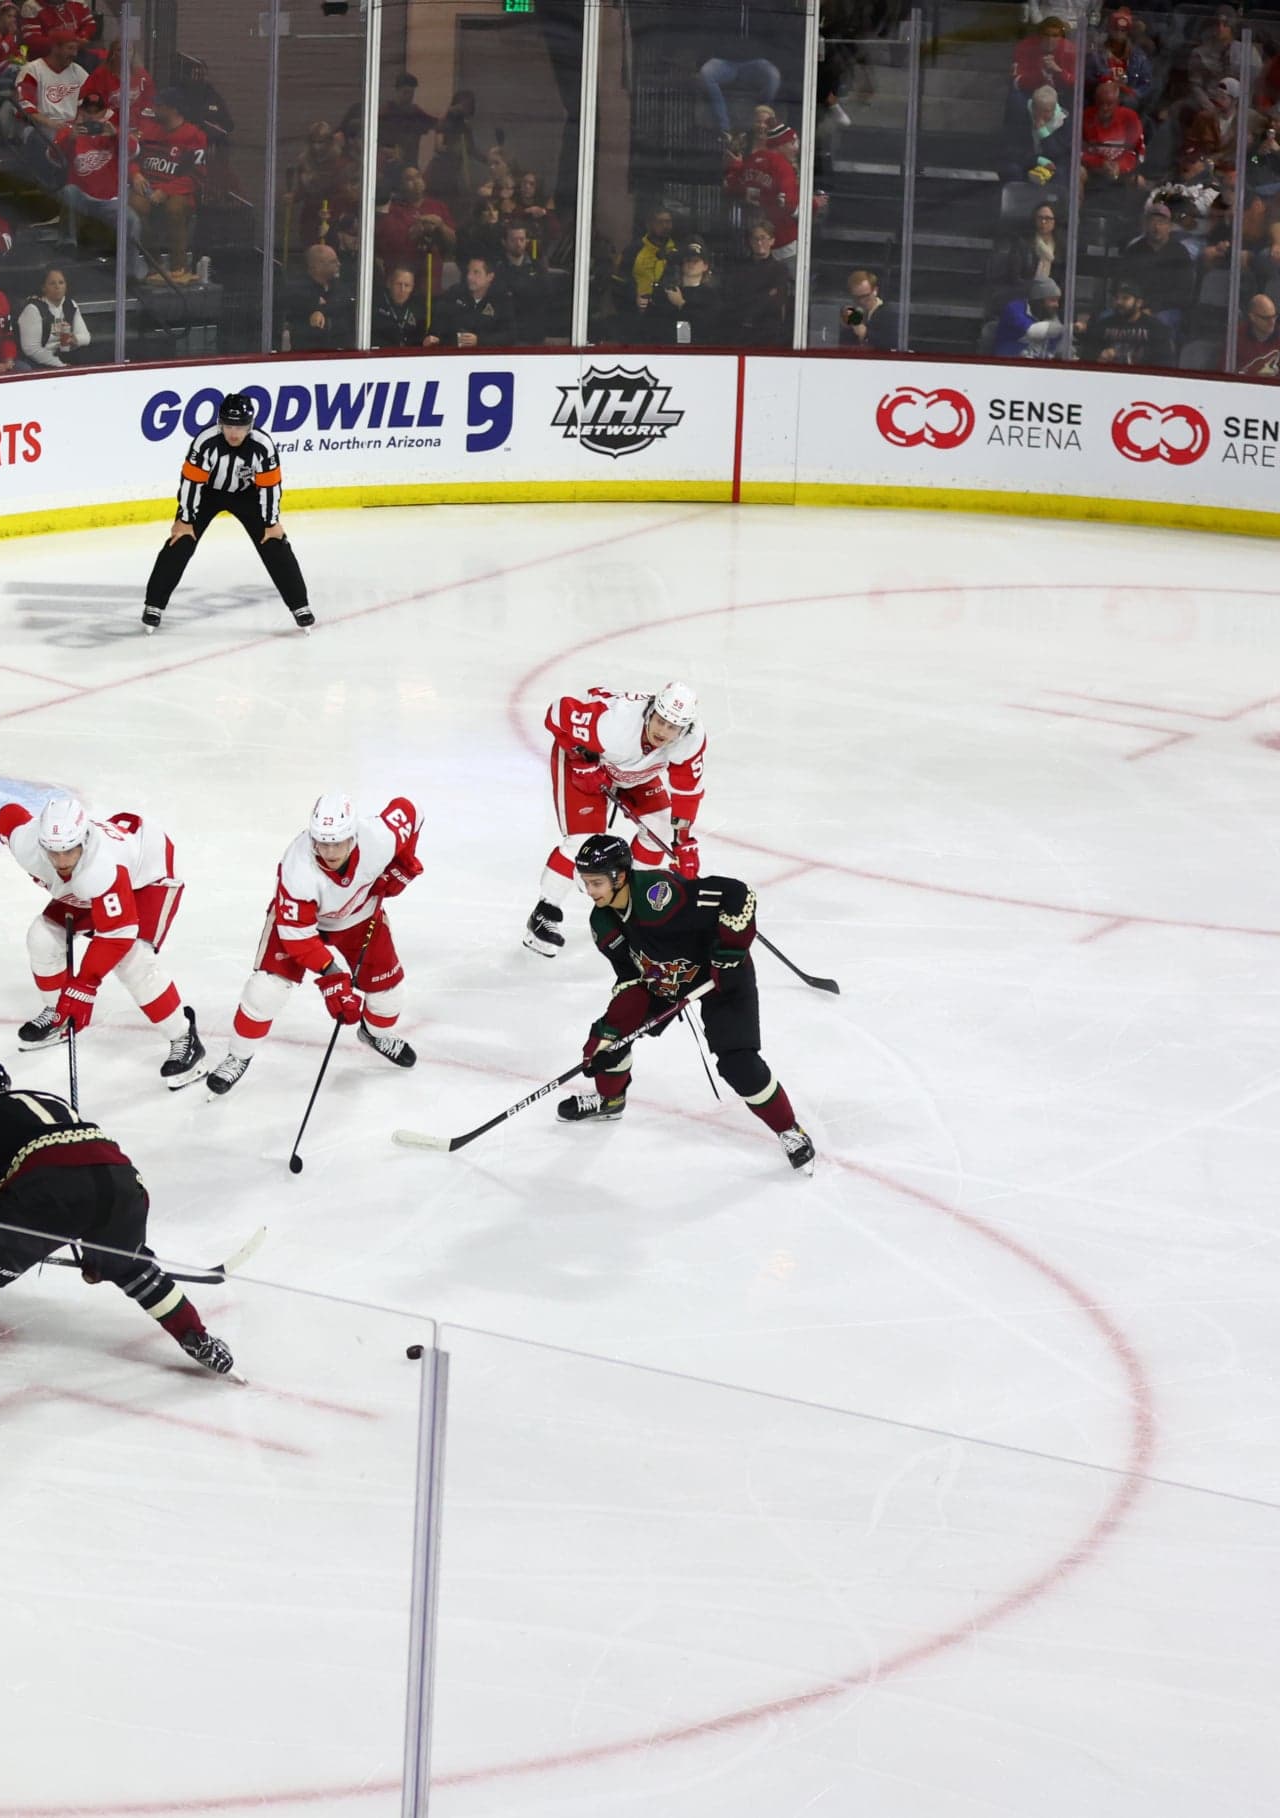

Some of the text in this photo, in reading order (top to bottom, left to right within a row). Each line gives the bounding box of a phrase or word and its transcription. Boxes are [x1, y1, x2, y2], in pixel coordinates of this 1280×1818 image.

[551, 387, 685, 425] NHL
[988, 398, 1083, 425] SENSE
[567, 424, 665, 437] NETWORK
[986, 424, 1082, 451] ARENA
[1223, 416, 1279, 442] SEN
[272, 439, 300, 453] tral
[303, 438, 313, 452] &
[386, 435, 442, 448] Arizona
[1222, 442, 1277, 467] ARE
[322, 815, 333, 826] 23
[384, 807, 413, 844] 23
[102, 892, 124, 918] 8
[505, 1078, 561, 1120] BAUER
